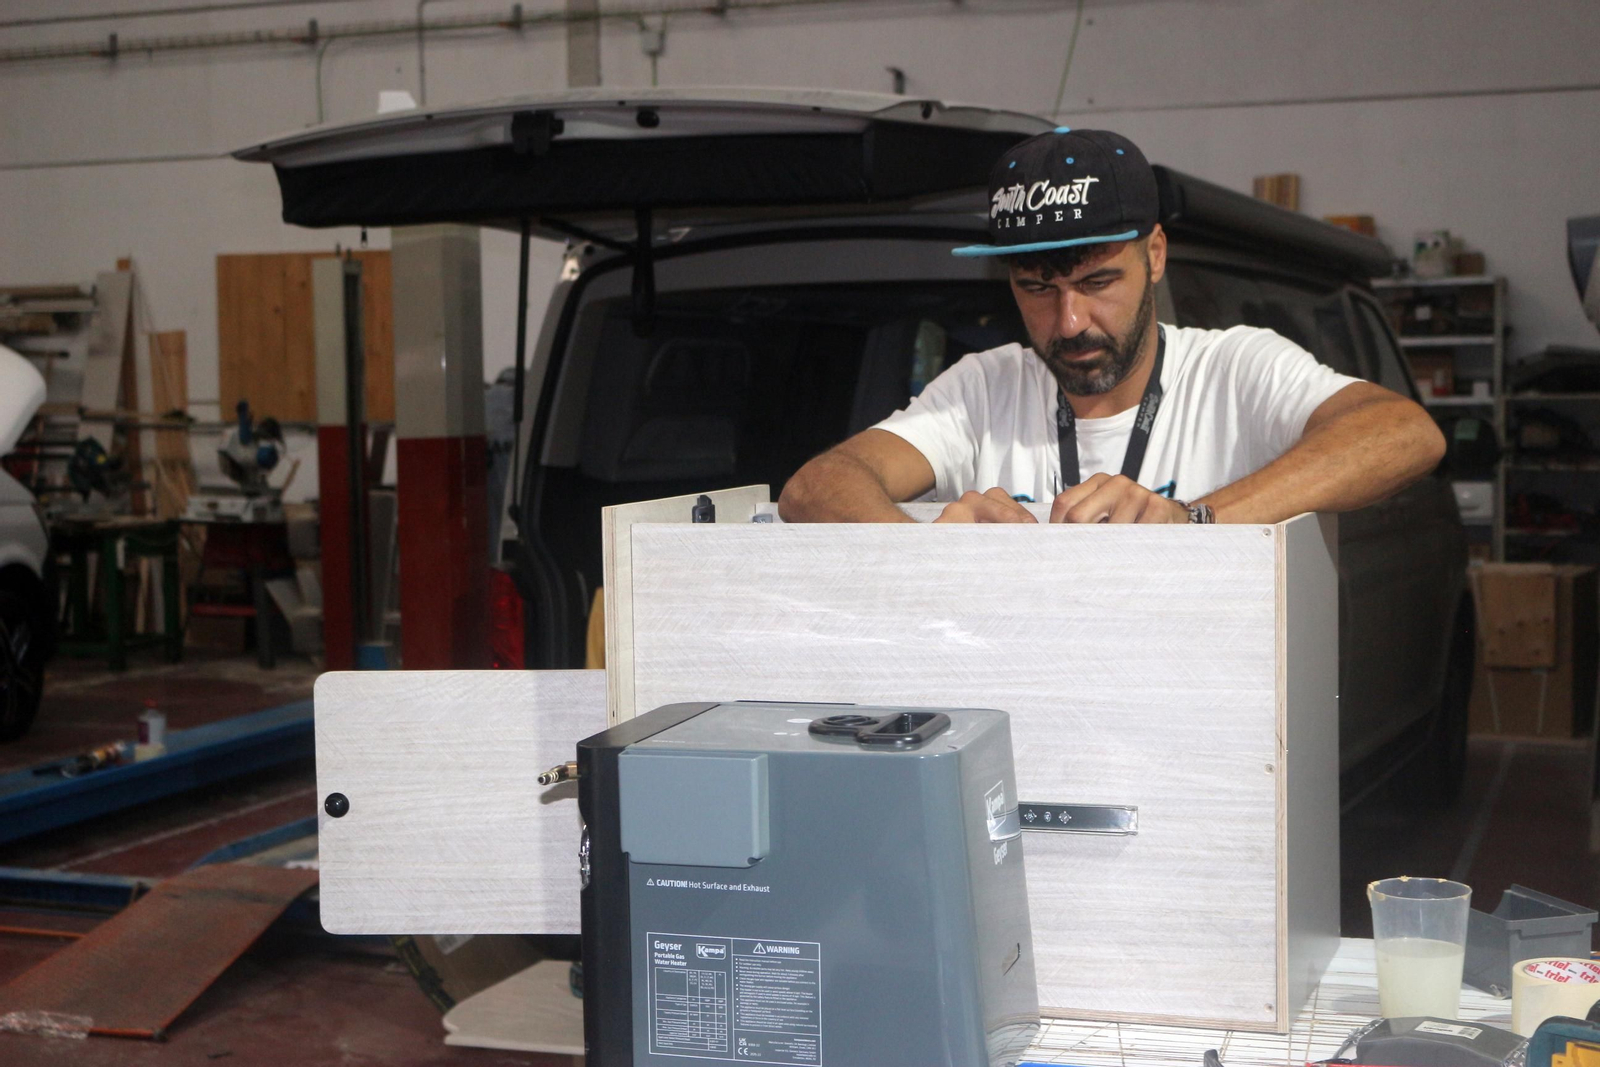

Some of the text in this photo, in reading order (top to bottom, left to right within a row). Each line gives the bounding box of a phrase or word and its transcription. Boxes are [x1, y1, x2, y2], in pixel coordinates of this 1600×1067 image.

[991, 175, 1099, 219] South Coast
[997, 208, 1083, 229] CAMPER
[993, 841, 1008, 865] Geyser
[656, 879, 770, 893] CAUTION! Hot Surface and Exhaust
[654, 940, 682, 952] Geyser
[698, 945, 724, 957] Kampa
[766, 945, 800, 955] WARNING
